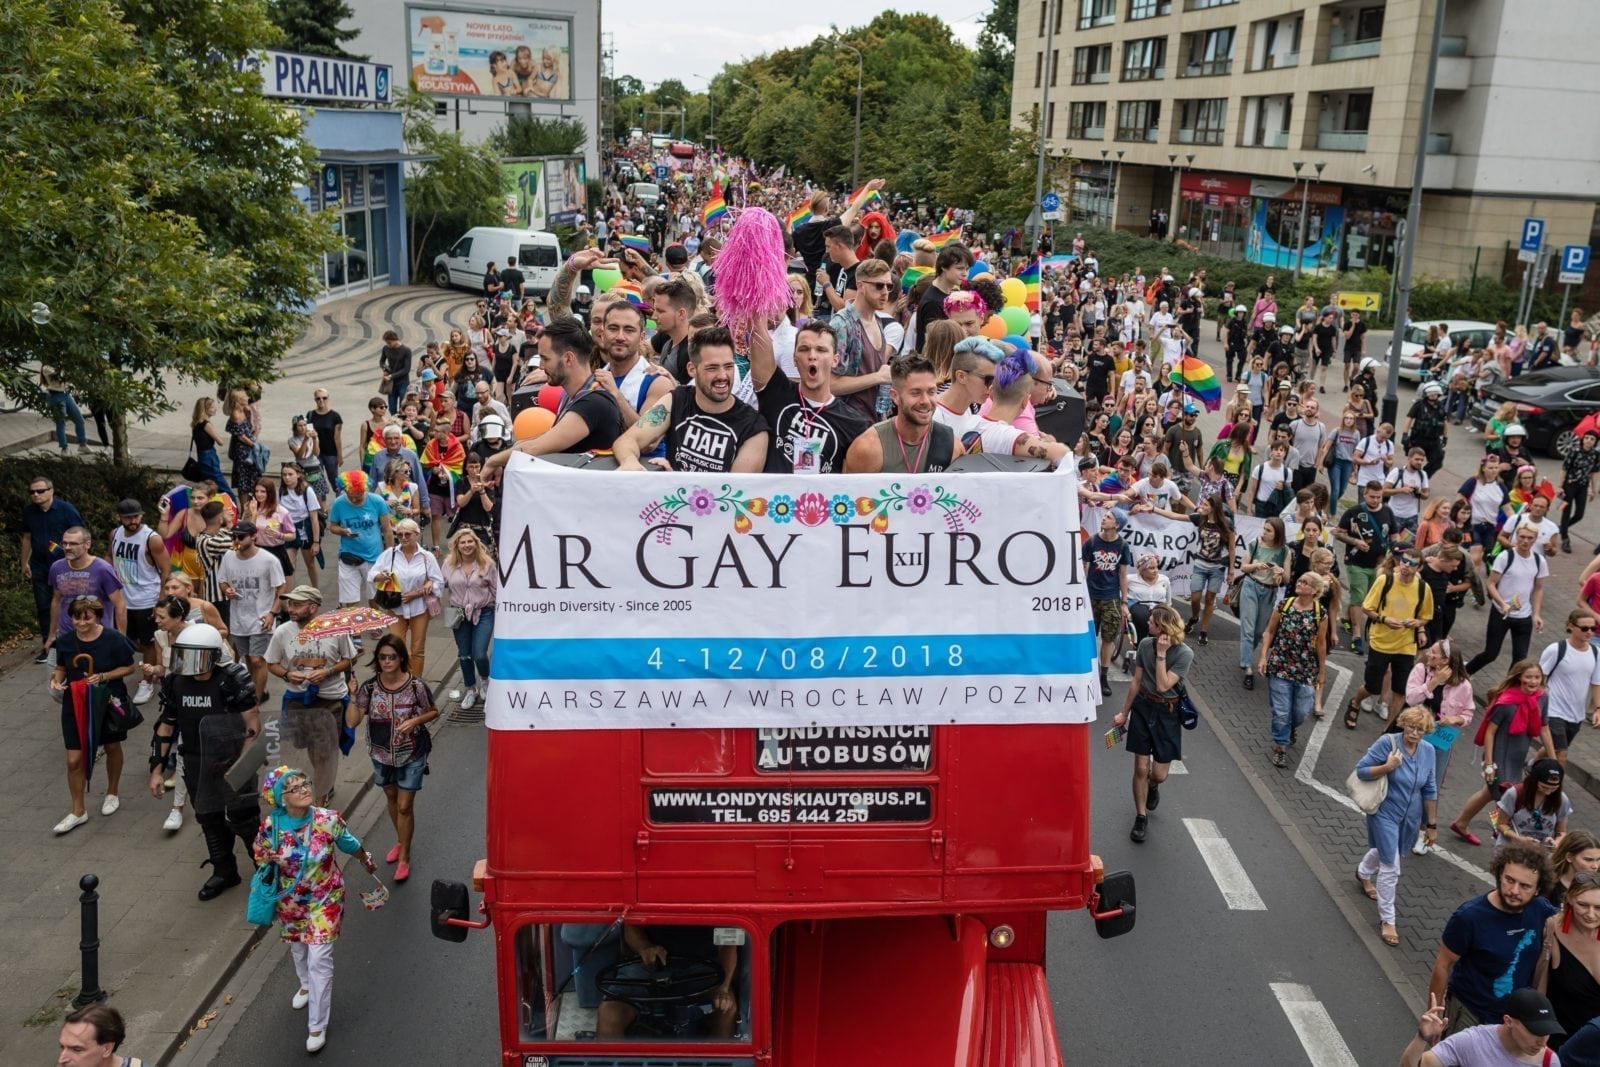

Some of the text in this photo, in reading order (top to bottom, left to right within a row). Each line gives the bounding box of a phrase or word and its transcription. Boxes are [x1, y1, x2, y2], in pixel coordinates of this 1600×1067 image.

[275, 54, 369, 98] PRALNIA
[1526, 221, 1541, 242] P
[1567, 248, 1585, 269] P
[682, 425, 729, 459] HAH
[116, 540, 141, 560] AM
[499, 524, 612, 589] MR
[635, 523, 803, 590] GAY
[893, 551, 923, 567] XII
[503, 601, 556, 614] Through
[560, 600, 615, 614] Diversity
[626, 600, 660, 612] Since
[663, 600, 692, 611] 2005
[1032, 596, 1071, 612] 2018
[182, 695, 212, 708] POLICJA
[507, 689, 708, 710] WARSZAWA
[748, 686, 923, 708] WROCŁAW
[964, 680, 1095, 705] POZNAŃ
[264, 719, 281, 761] ICJA
[758, 741, 930, 768] AUTOBUSÓW
[653, 791, 926, 807] WWW.LONDYNSKIAUTOBUS.PL
[712, 809, 869, 823] TEL. 695 444 250
